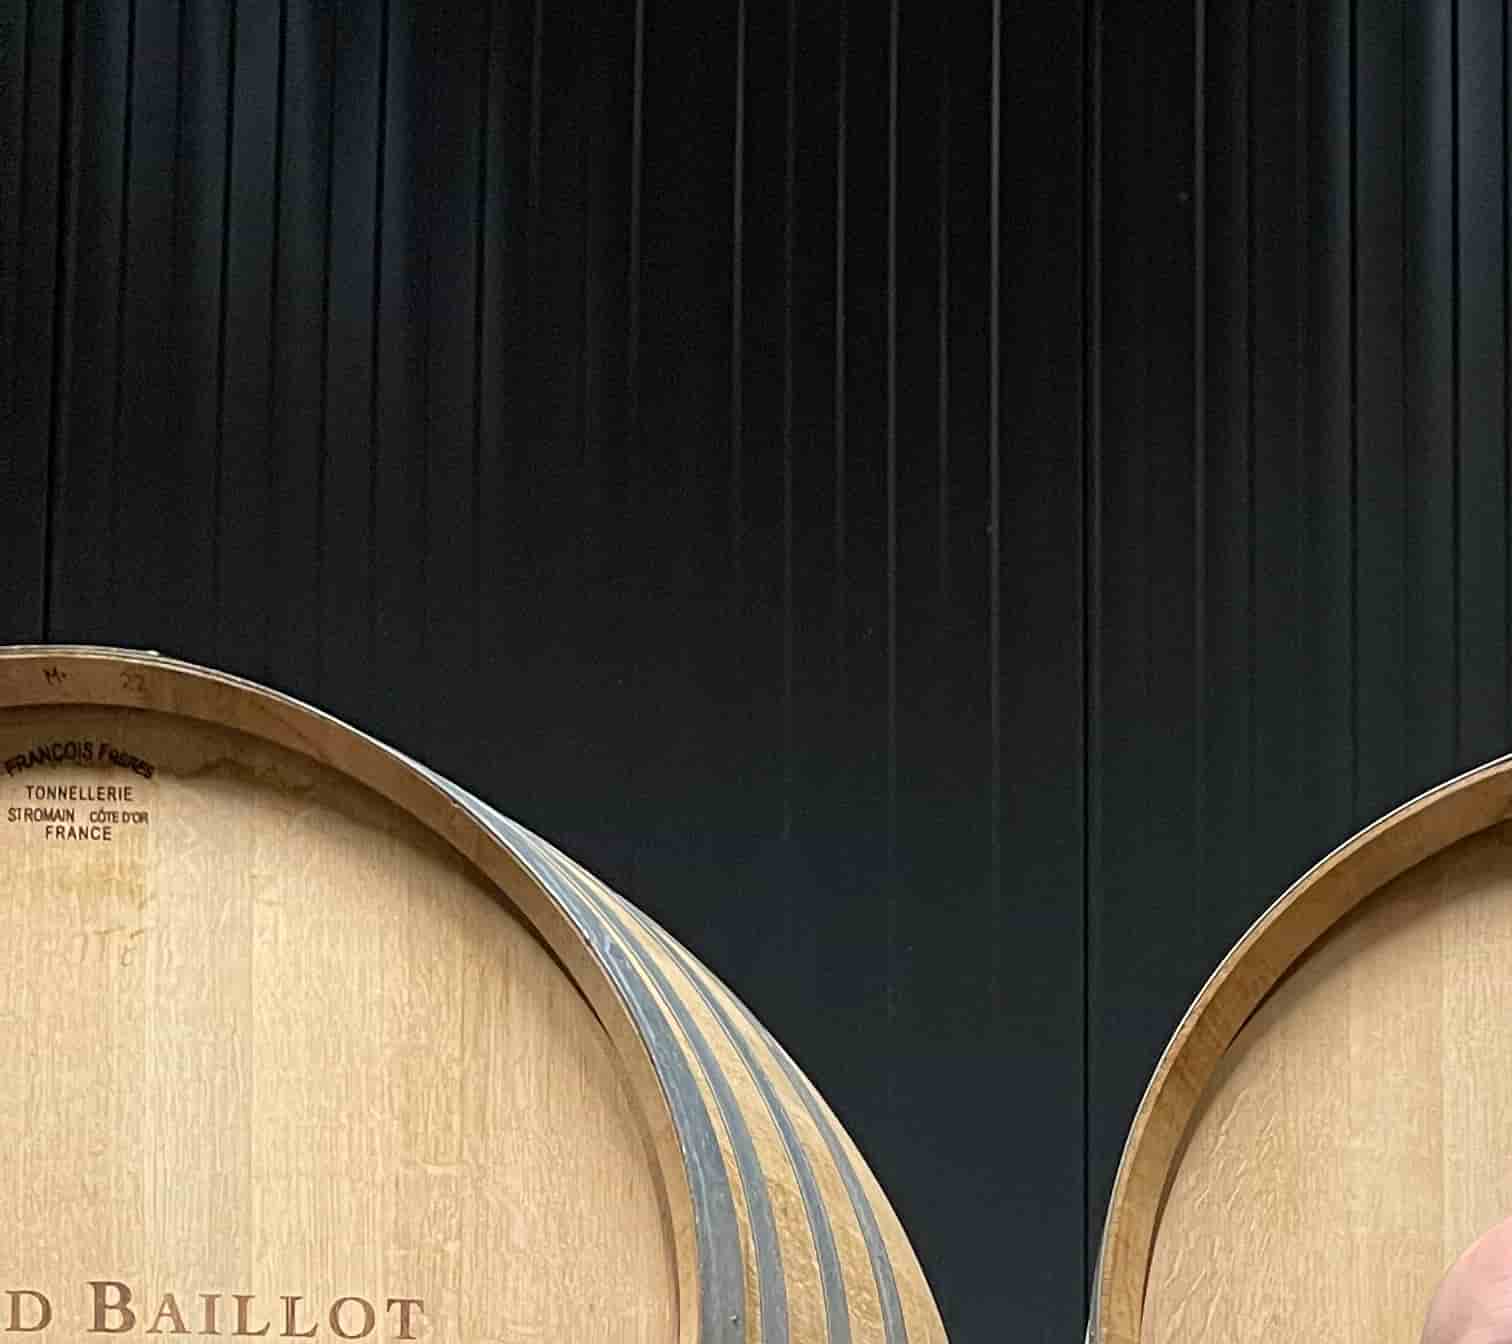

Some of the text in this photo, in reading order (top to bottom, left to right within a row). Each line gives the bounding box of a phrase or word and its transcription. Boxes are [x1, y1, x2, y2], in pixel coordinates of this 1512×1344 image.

[25, 785, 134, 801] TONNELLERIE
[45, 825, 113, 841] FRANCE
[86, 1281, 425, 1340] BAILLOT
